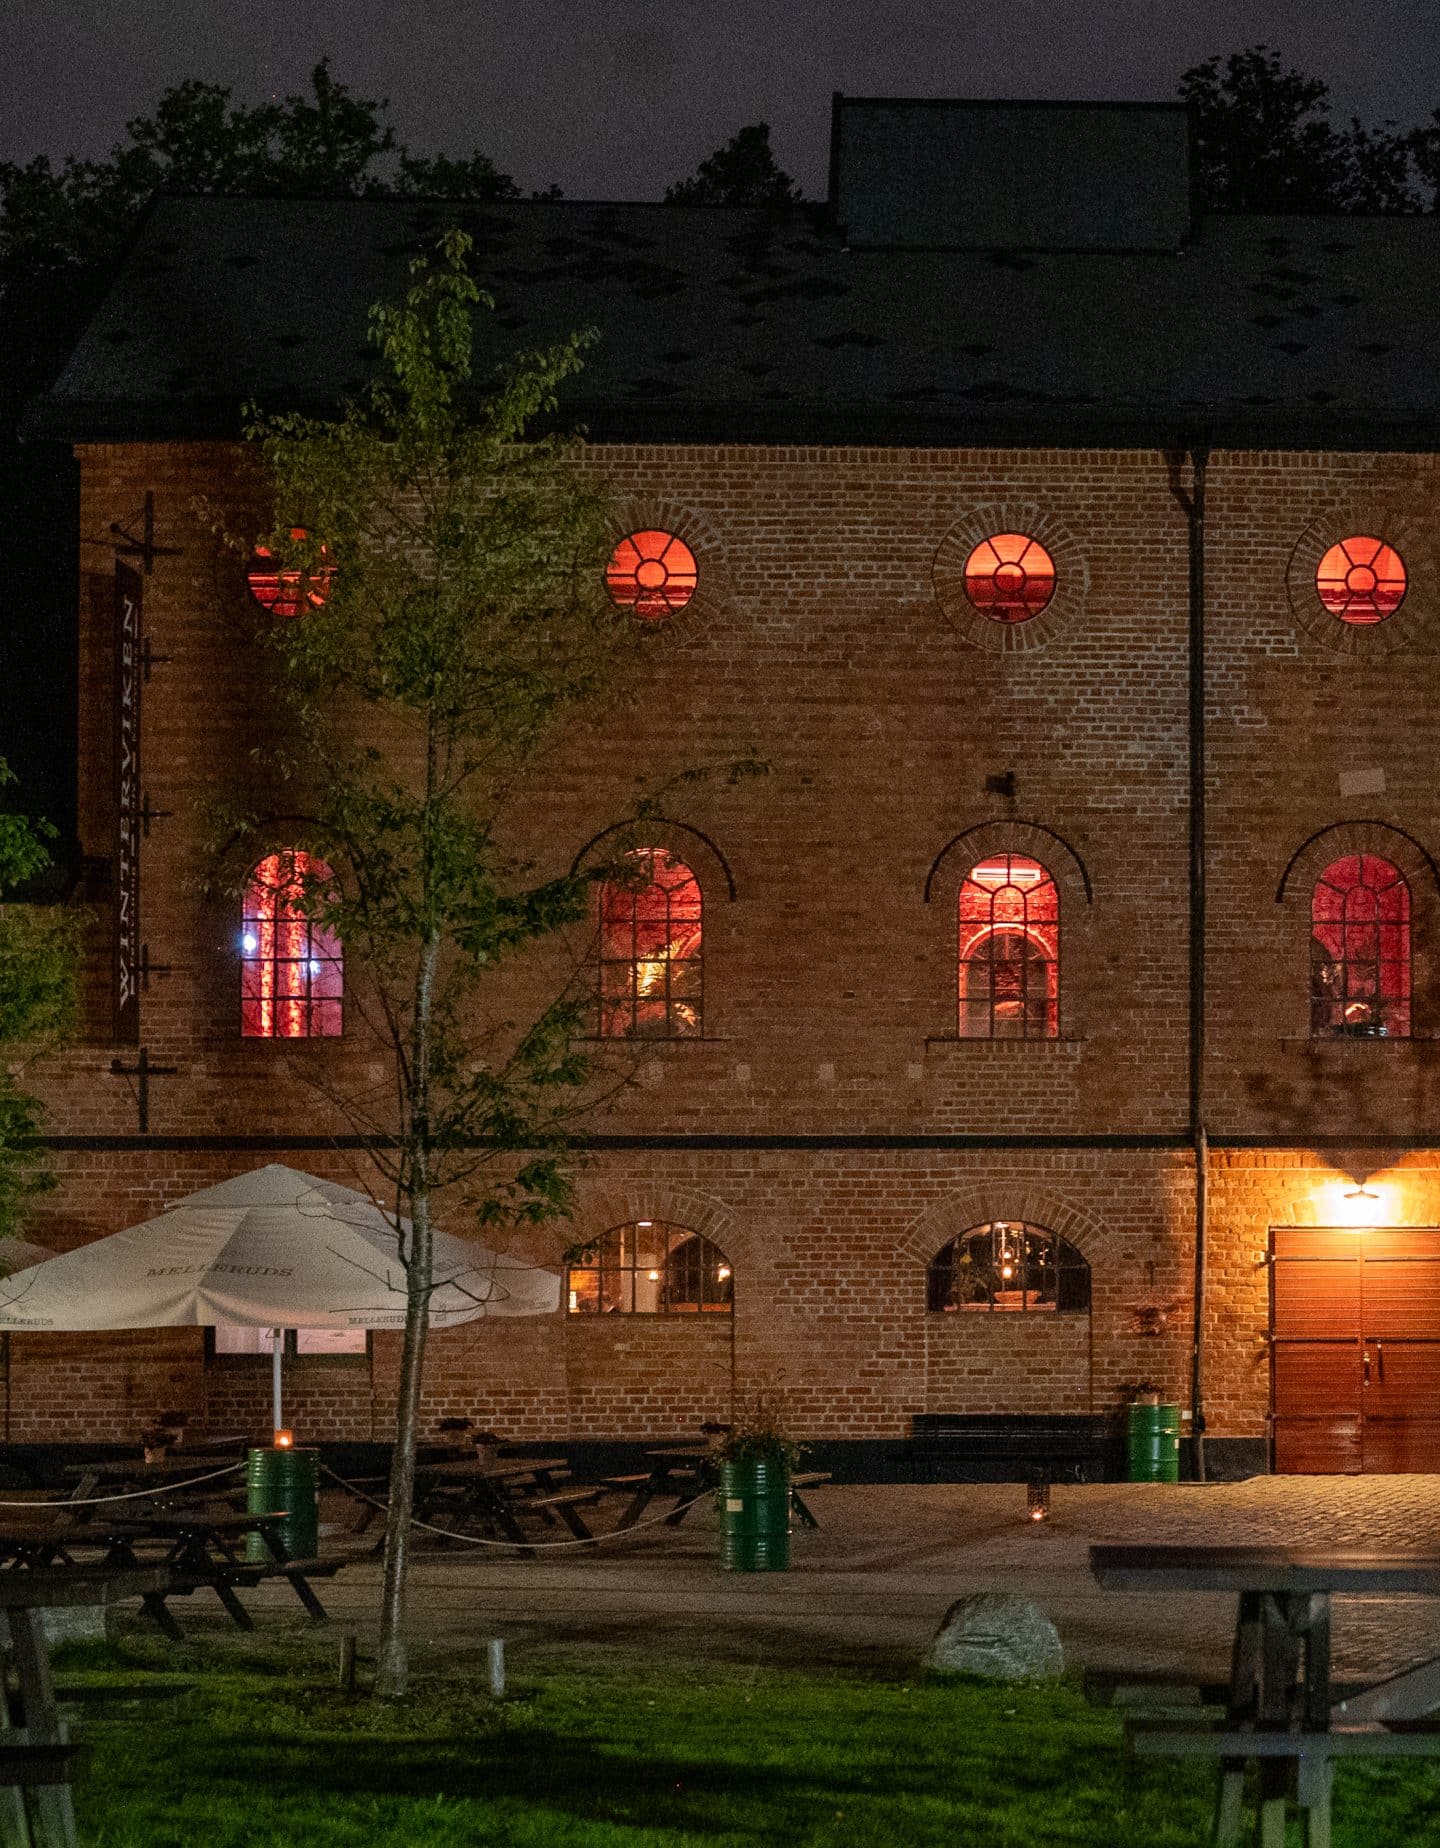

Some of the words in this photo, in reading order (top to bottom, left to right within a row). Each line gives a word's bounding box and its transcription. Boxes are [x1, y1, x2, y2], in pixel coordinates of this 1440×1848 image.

[120, 594, 133, 1011] WINTERVIKEN
[147, 1264, 293, 1277] MELLERUDS
[349, 1315, 407, 1325] MELLERUD
